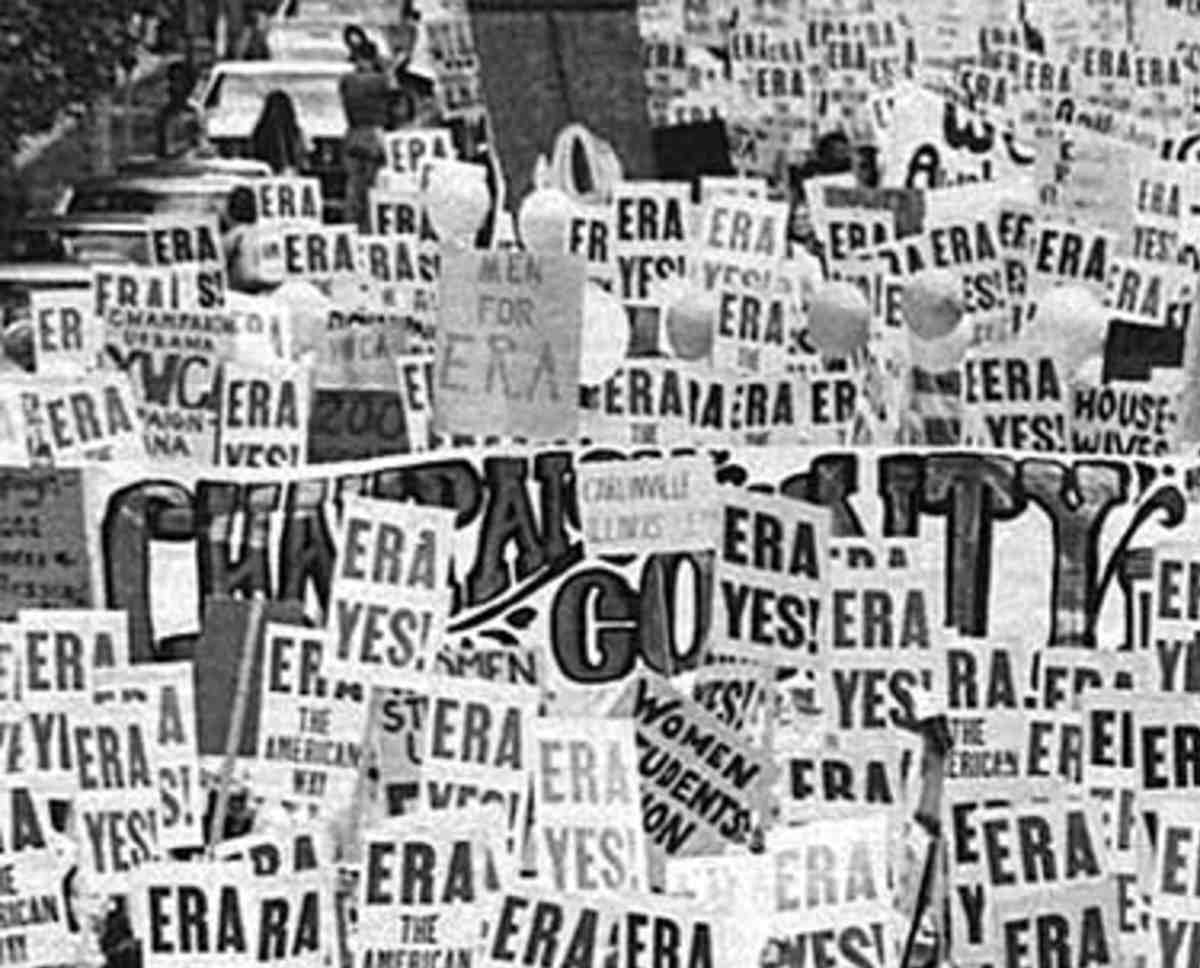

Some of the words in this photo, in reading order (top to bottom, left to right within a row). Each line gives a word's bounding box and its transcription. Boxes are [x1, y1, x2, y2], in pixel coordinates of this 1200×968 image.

[1025, 61, 1071, 93] ERA
[1084, 47, 1131, 78] ERA
[1135, 57, 1181, 87] ERA
[259, 185, 319, 218] ERA
[617, 198, 685, 241] ERA
[152, 226, 219, 264] ERA
[285, 233, 354, 274] ERA
[708, 206, 775, 256] ERA
[930, 221, 996, 268] ERA
[1036, 229, 1107, 282] ERA
[479, 256, 543, 285] MEN
[477, 297, 537, 326] FOR
[719, 293, 783, 346] ERA
[439, 333, 562, 403] ERA
[980, 357, 1062, 402] ERA
[47, 386, 132, 448] ERA
[227, 380, 298, 429] ERA
[985, 413, 1067, 452] YES!
[341, 516, 437, 590] ERA
[722, 504, 820, 580] ERA
[336, 598, 433, 672] YES!
[719, 579, 820, 654] YES!
[832, 589, 932, 649] ERA
[73, 723, 153, 791] ERA
[431, 697, 522, 770] ERA
[634, 678, 760, 790] WOMEN
[539, 740, 632, 804] ERA
[83, 809, 163, 874] YES!
[544, 827, 642, 892] YES!
[983, 811, 1103, 887] ERA
[366, 841, 476, 905] ERA
[775, 846, 878, 912] ERA
[149, 885, 247, 954] ERA
[400, 913, 439, 945] THE
